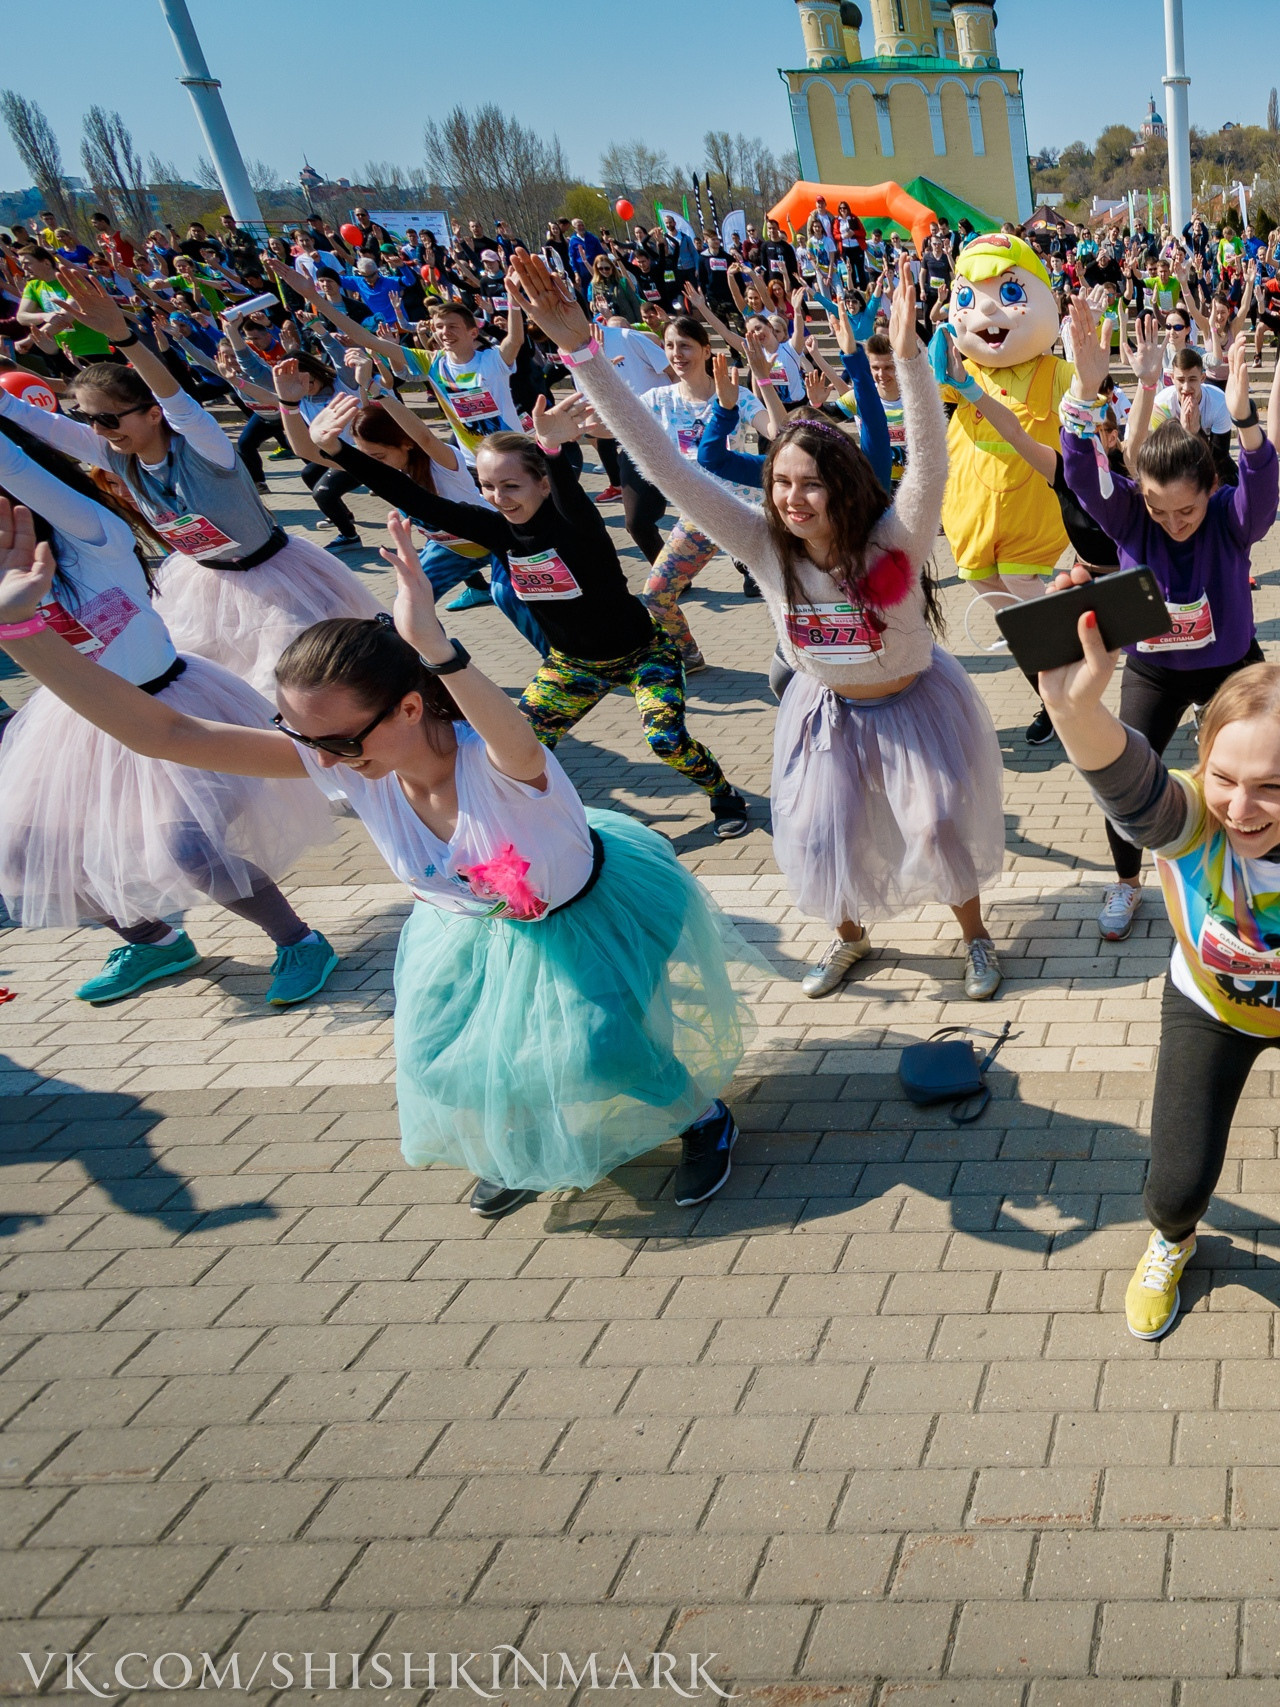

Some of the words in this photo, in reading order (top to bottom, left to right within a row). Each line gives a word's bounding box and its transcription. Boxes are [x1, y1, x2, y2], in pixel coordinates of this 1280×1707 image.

[27, 392, 53, 407] hh
[174, 532, 210, 548] 708
[514, 573, 556, 586] 589
[808, 627, 857, 644] 877
[1170, 622, 1198, 635] 07
[1160, 635, 1195, 643] СВЕТЛАНА
